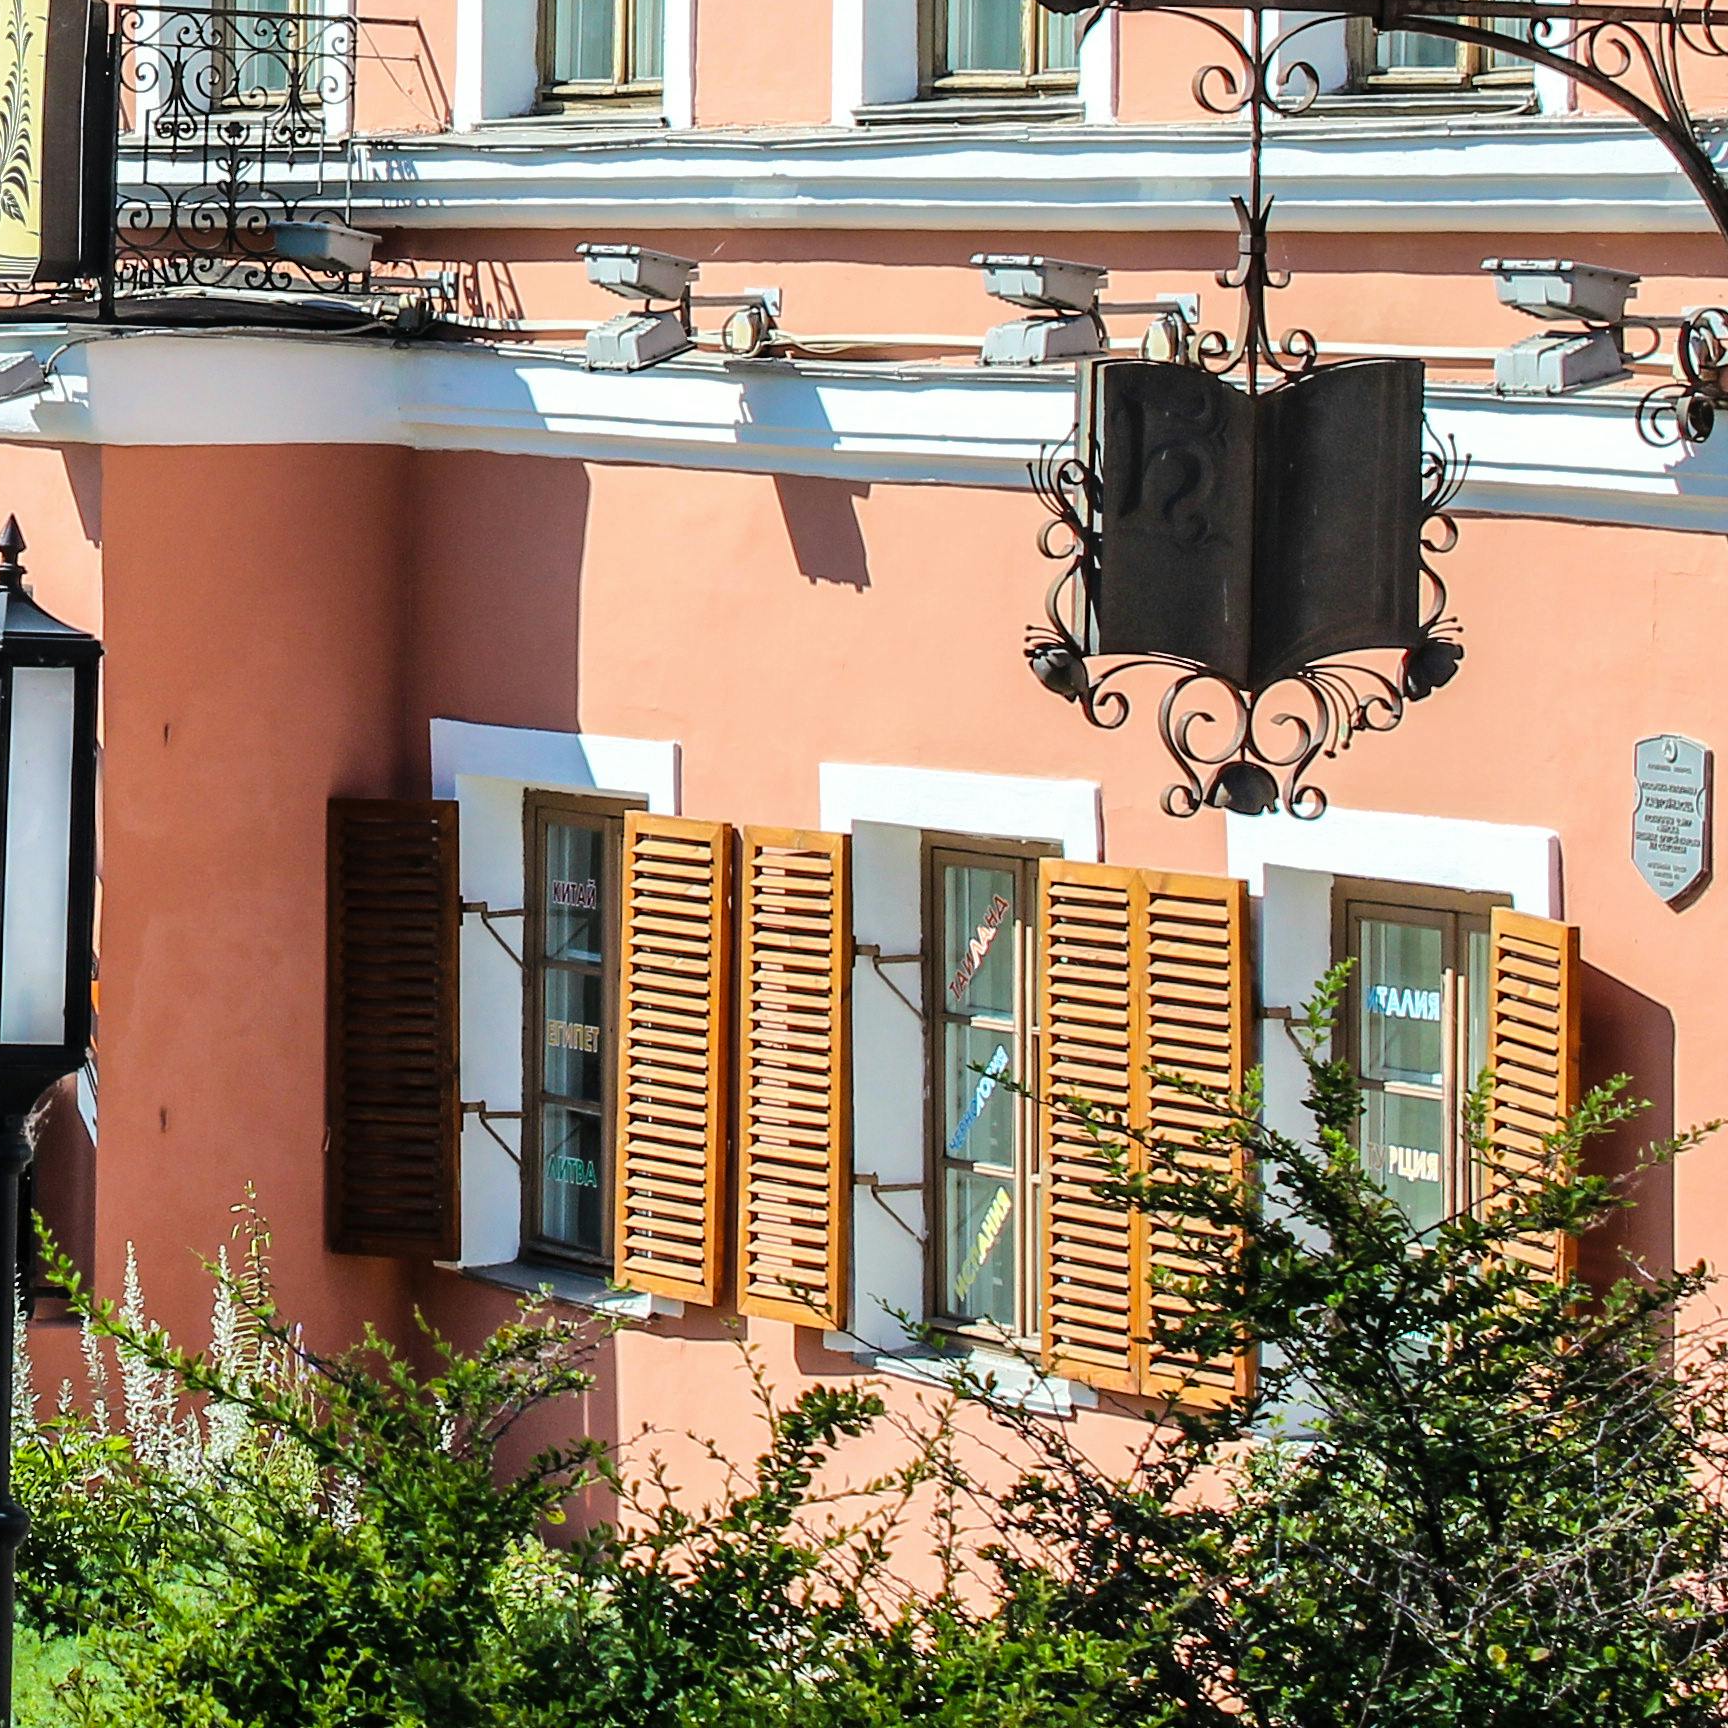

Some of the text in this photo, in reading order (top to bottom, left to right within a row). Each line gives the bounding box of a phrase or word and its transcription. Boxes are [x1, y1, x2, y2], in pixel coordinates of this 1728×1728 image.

[552, 879, 597, 910] КИТАЙ
[1365, 984, 1441, 1021] ИТАЛИЯ
[546, 1019, 600, 1053] ЕГИПЕТ
[546, 1153, 598, 1189] ЛИТВА
[1367, 1141, 1440, 1182] ТУРЦИЯ
[953, 1184, 1012, 1303] ИСПАНИЯ
